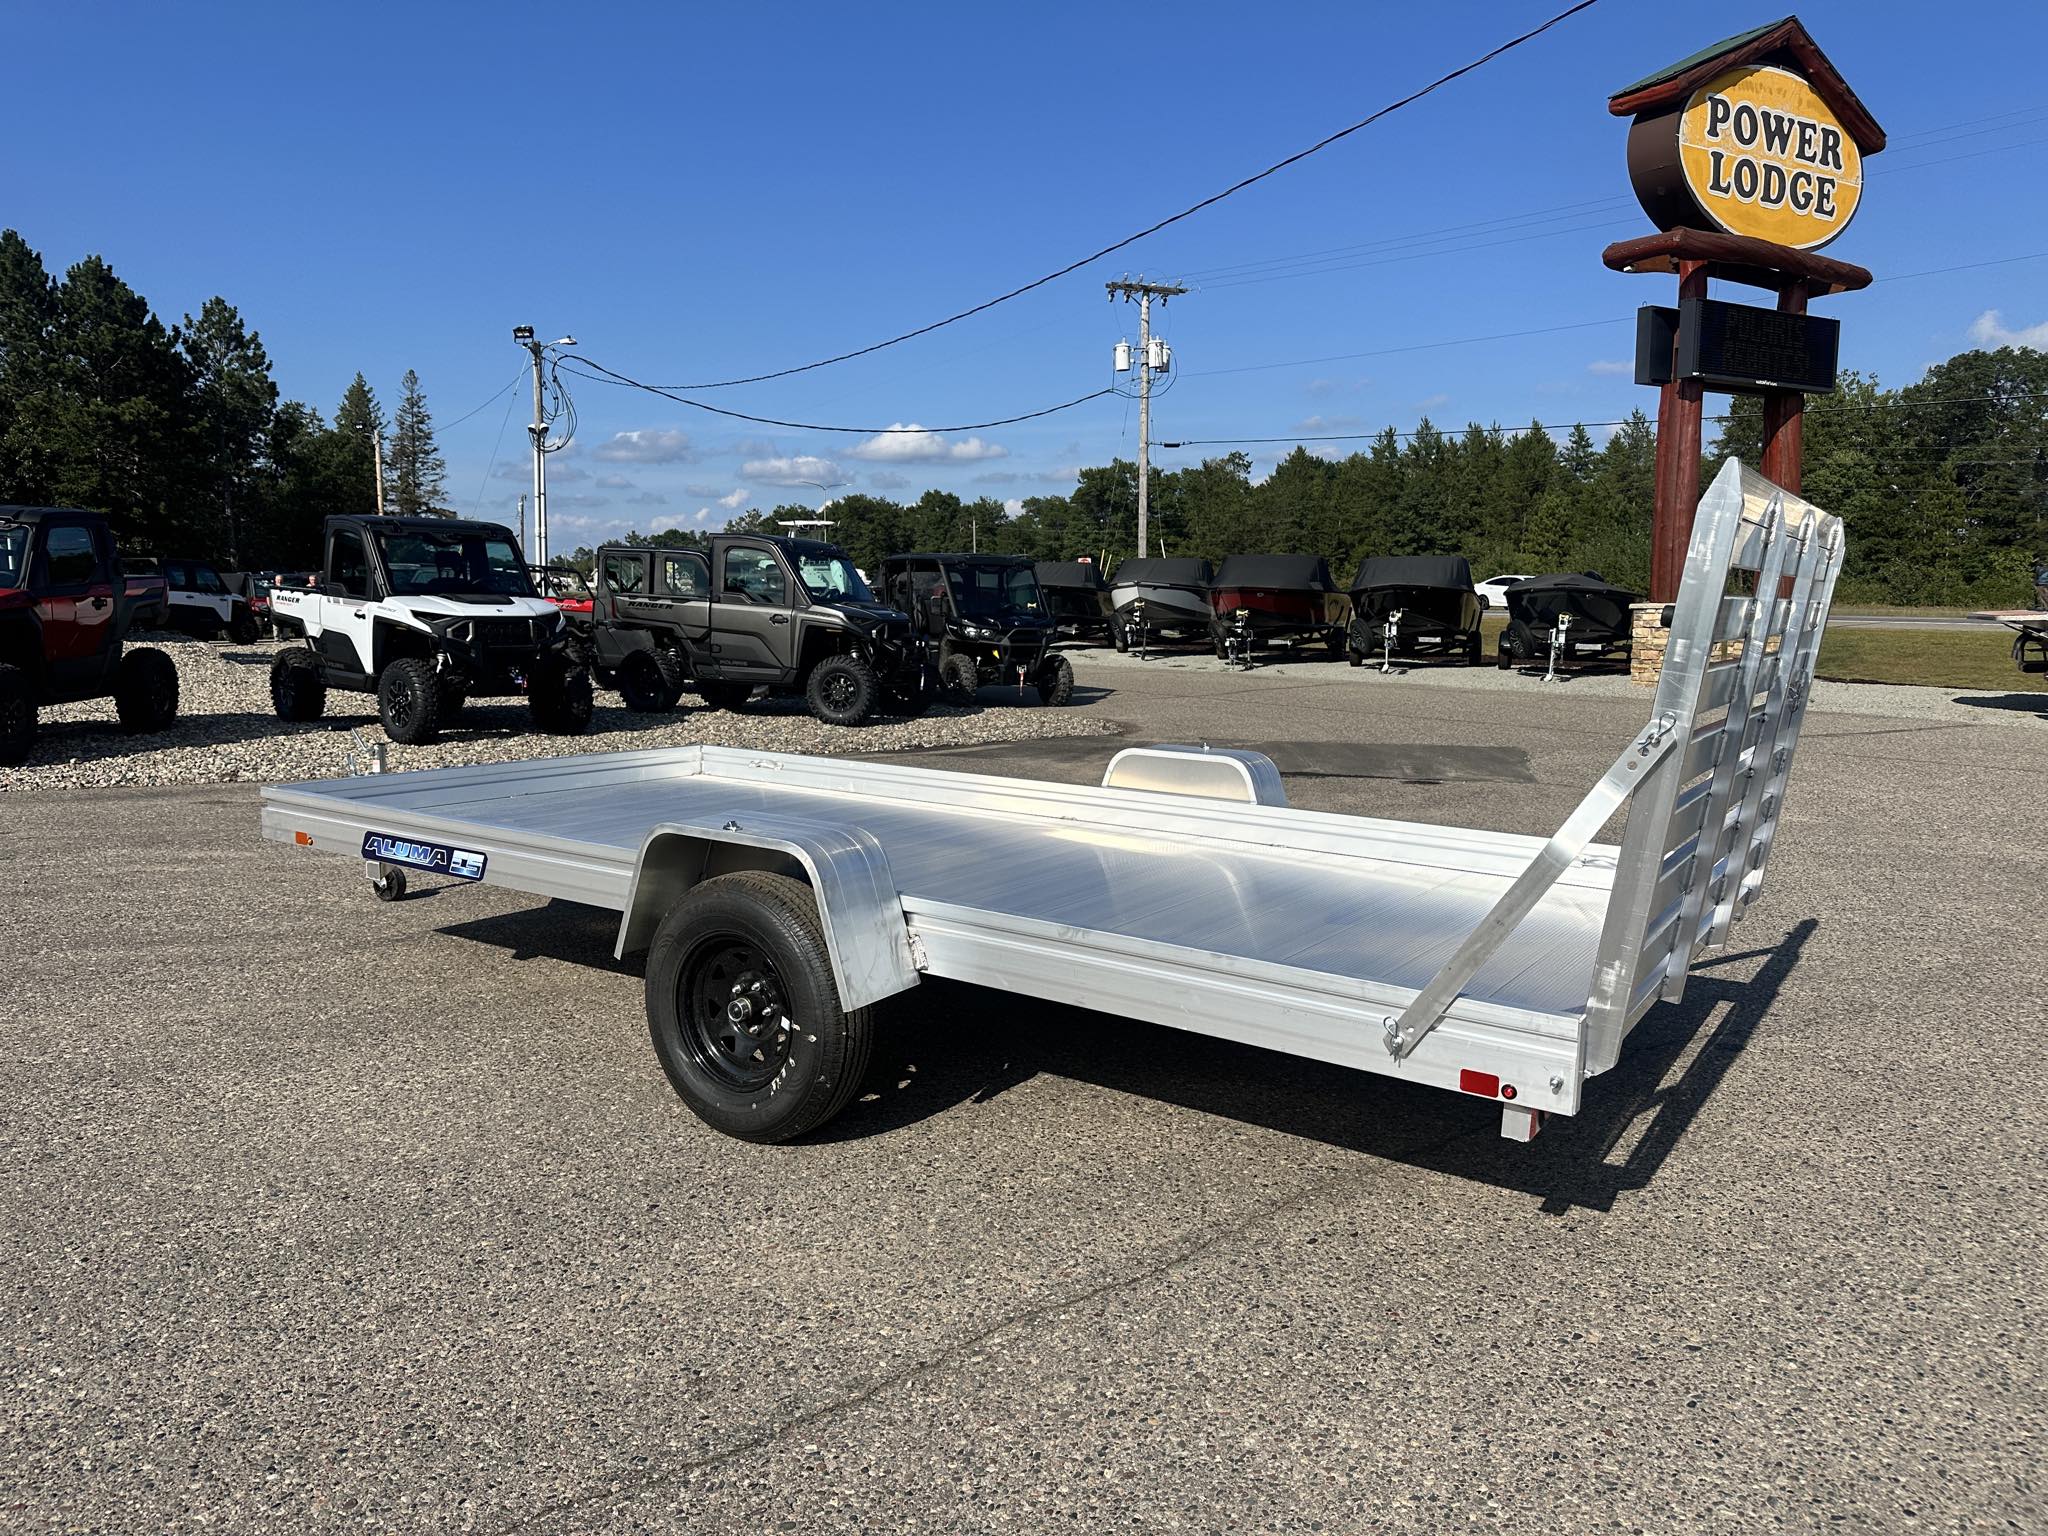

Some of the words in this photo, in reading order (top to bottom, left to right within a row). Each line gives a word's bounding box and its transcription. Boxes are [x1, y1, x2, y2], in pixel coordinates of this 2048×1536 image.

[1706, 95, 1843, 171] POWER
[1709, 150, 1837, 218] LODGE
[276, 595, 300, 603] RANGER
[627, 601, 673, 609] RANGER
[365, 836, 447, 866] ALUMA
